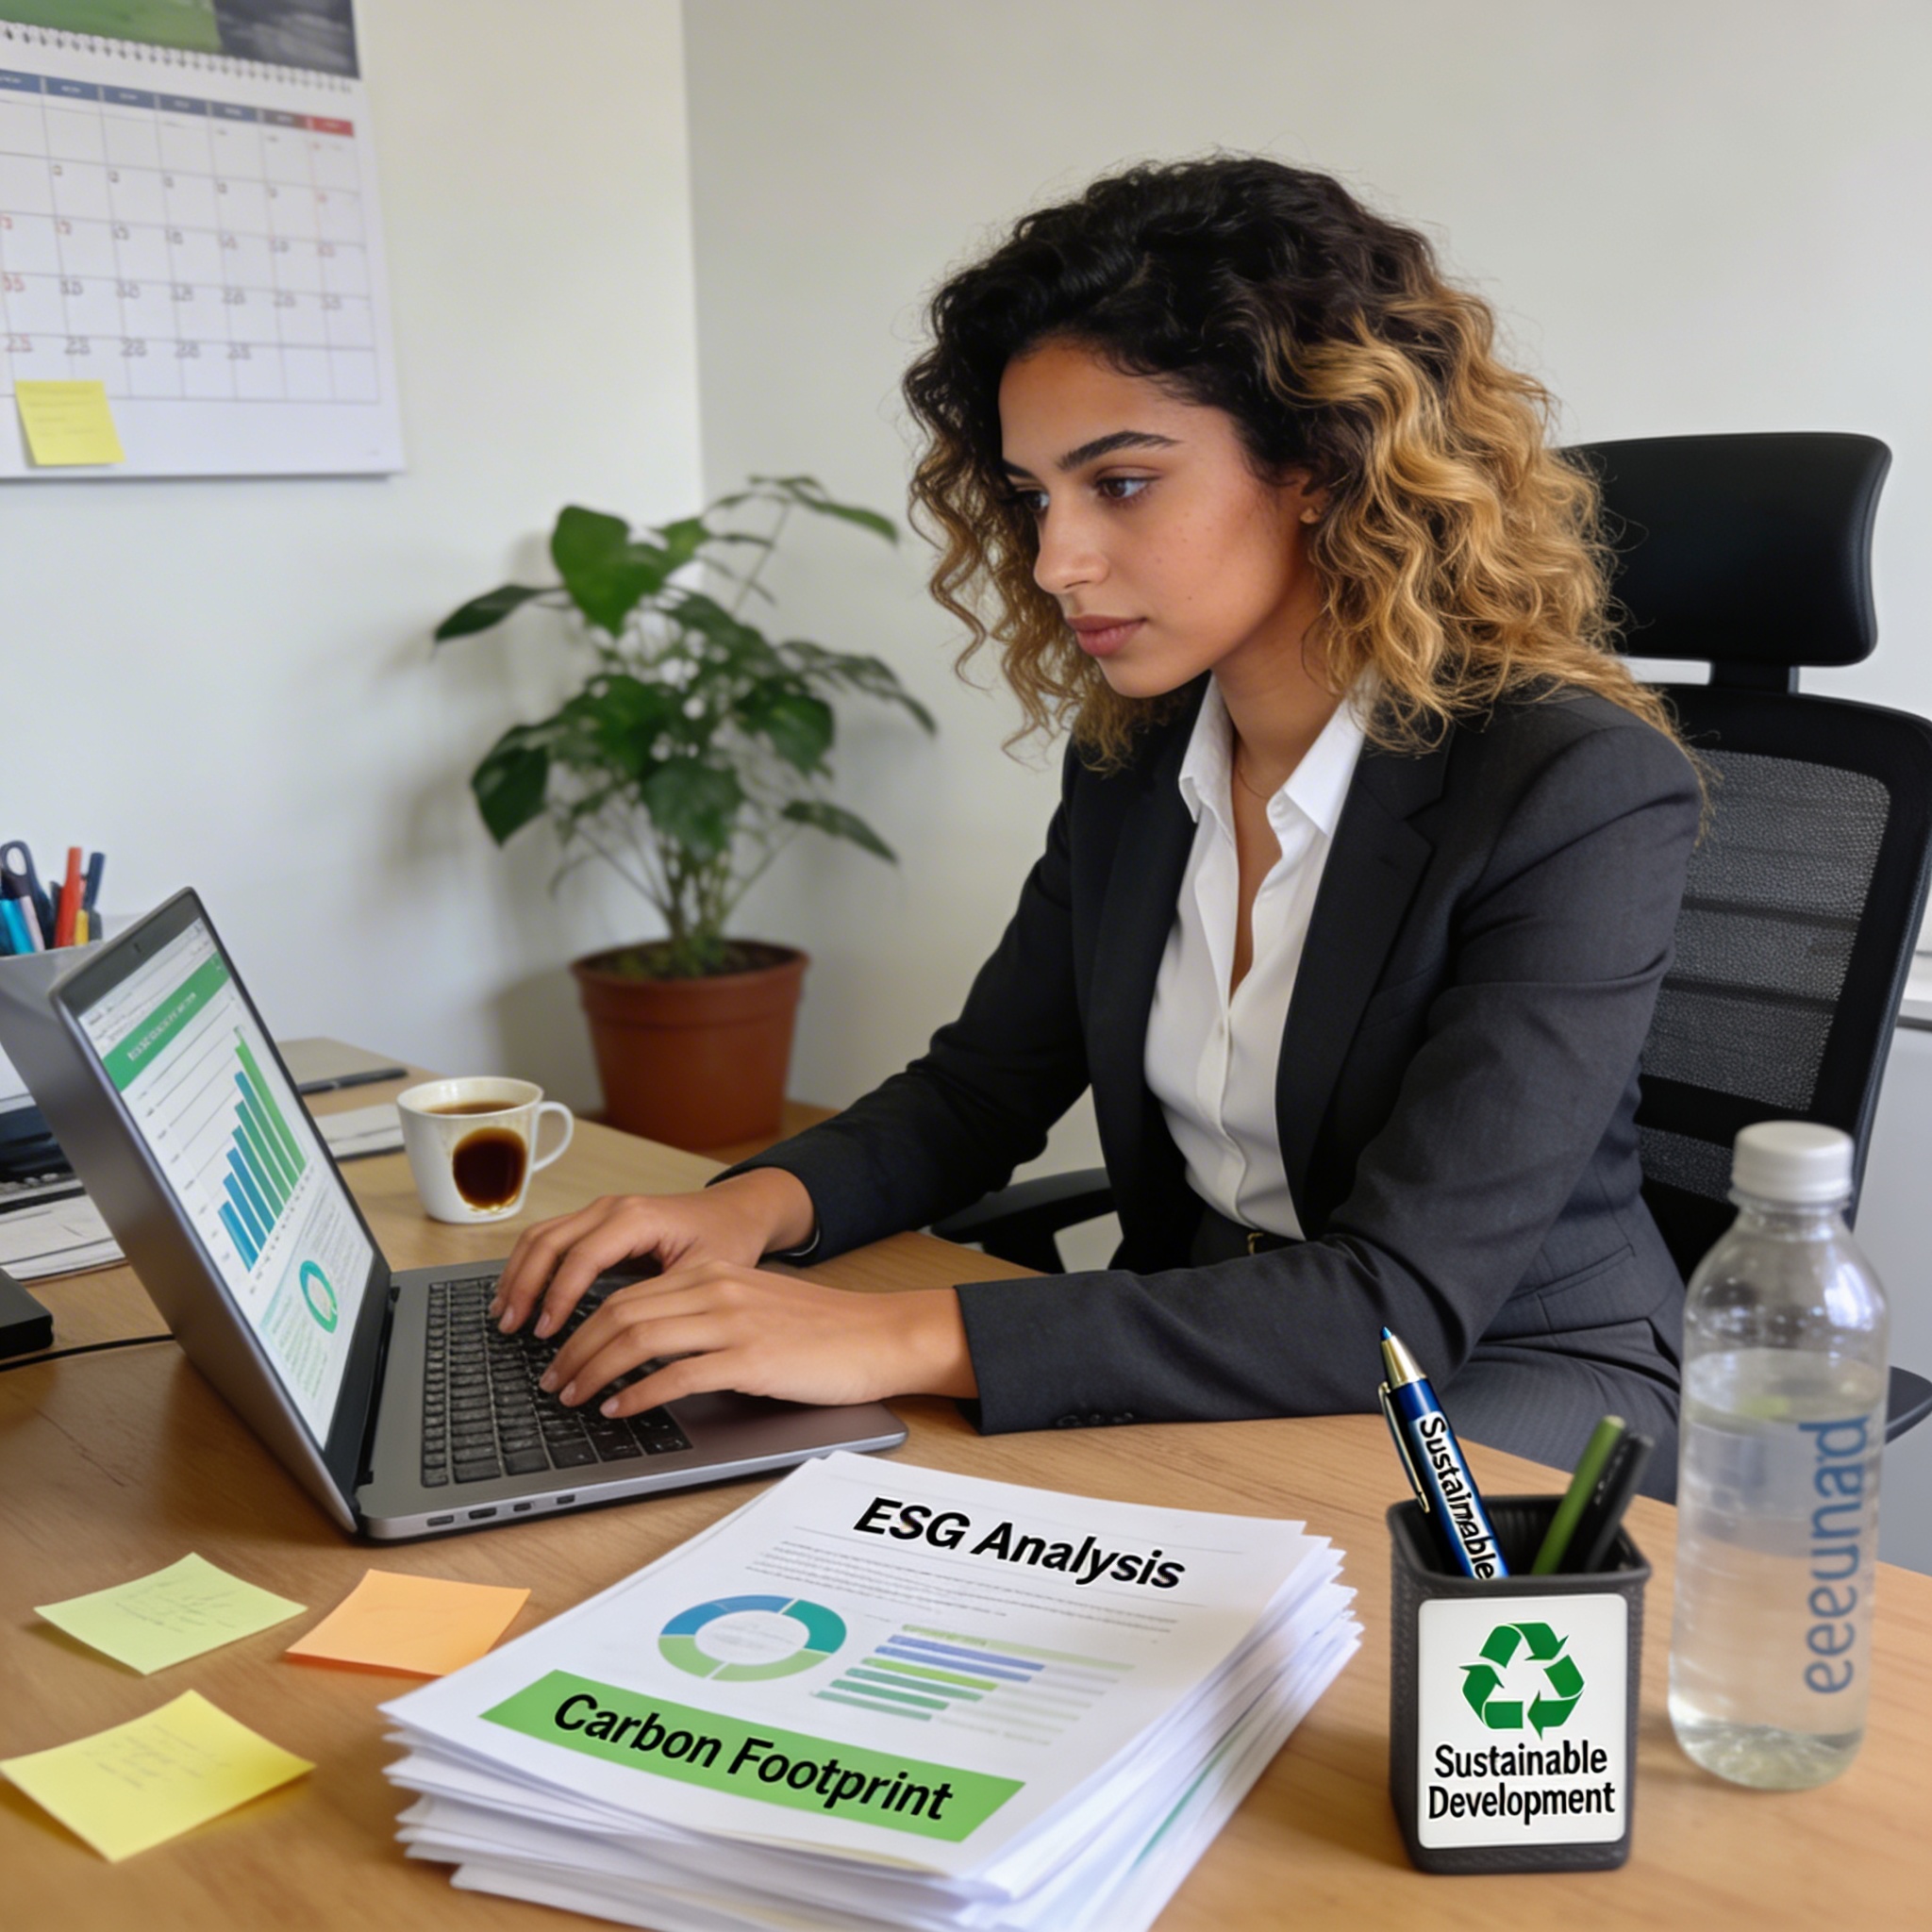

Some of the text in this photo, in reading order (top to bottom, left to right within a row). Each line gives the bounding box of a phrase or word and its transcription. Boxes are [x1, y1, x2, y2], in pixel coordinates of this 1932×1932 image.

[853, 1496, 971, 1550] ESG
[970, 1522, 1186, 1589] Analysis
[555, 1693, 954, 1821] Carbon Footprint
[1433, 1740, 1608, 1779] Sustainable
[1427, 1781, 1616, 1825] Development
